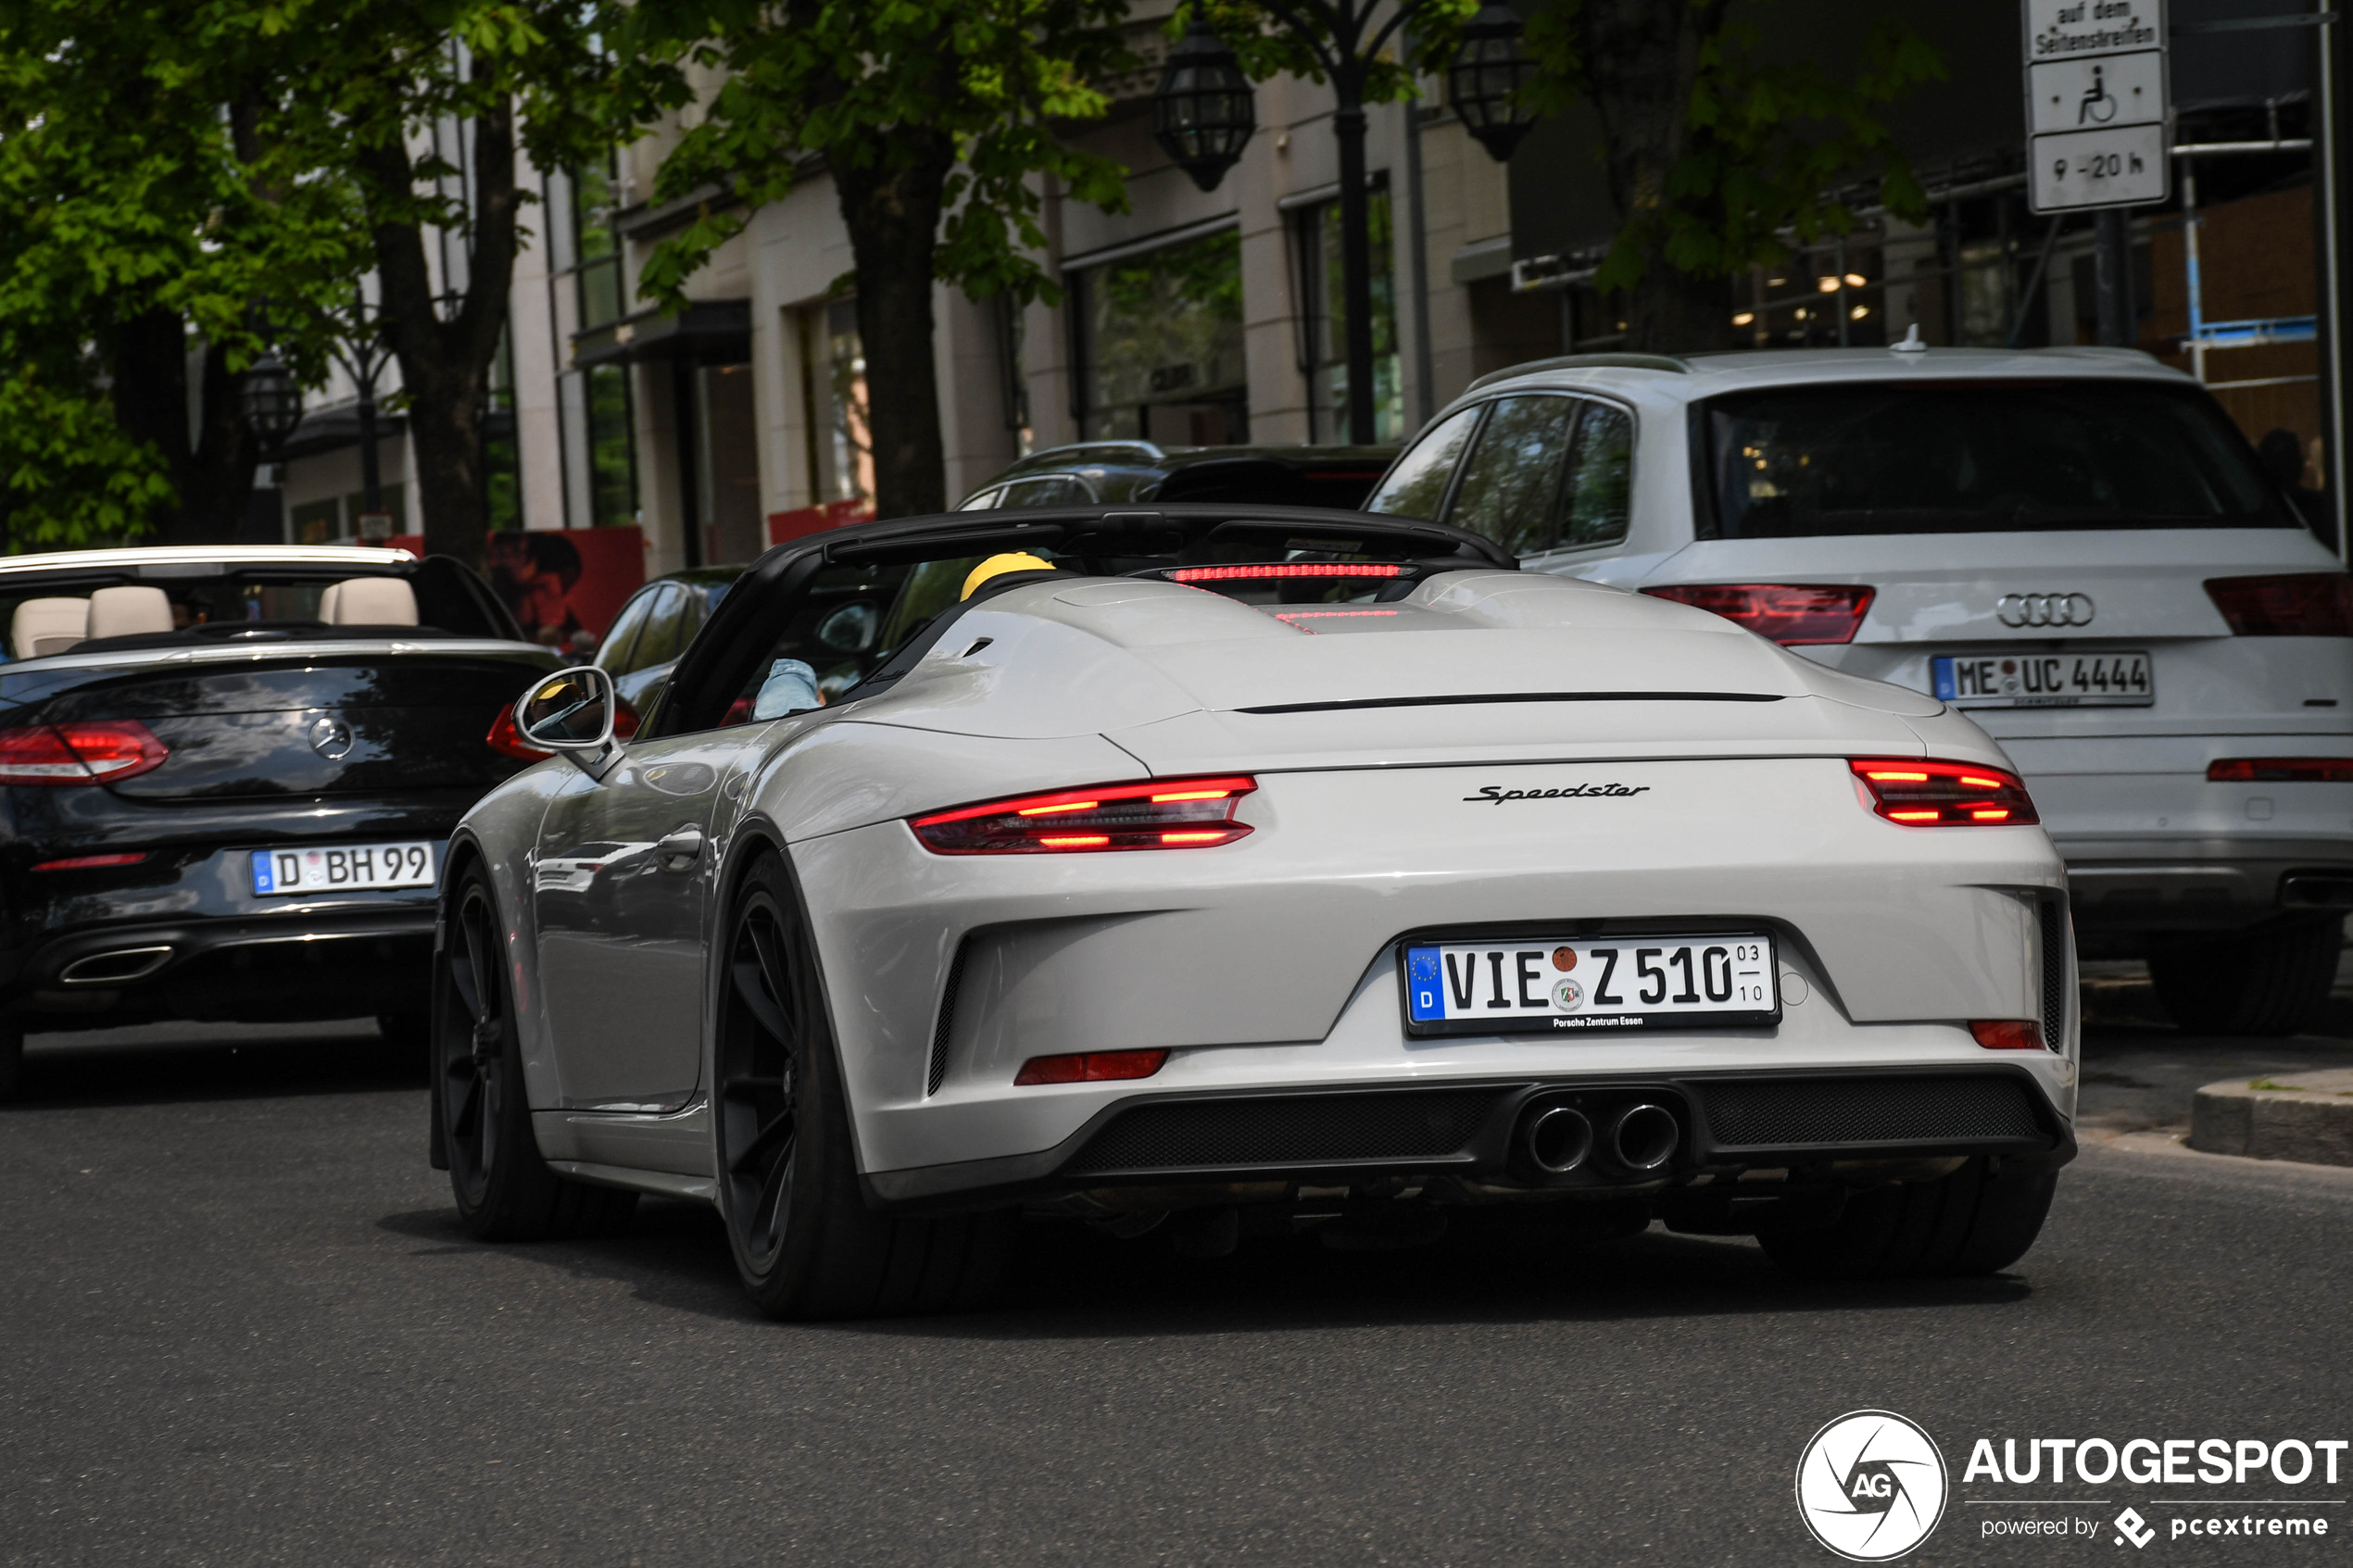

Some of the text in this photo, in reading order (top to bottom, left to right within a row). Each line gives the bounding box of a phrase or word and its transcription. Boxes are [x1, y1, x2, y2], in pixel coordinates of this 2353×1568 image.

[2057, 0, 2131, 24] auf dem
[2036, 25, 2155, 55] Seitenstreifen
[2129, 152, 2145, 174] h
[1957, 659, 2147, 696] ME UC 4444
[1463, 784, 1650, 806] Speedster
[276, 846, 426, 886] D BH 99
[1737, 945, 1760, 961] 03
[1446, 951, 1549, 1009] VIE
[1591, 948, 1623, 1005] Z
[1636, 947, 1733, 1004] 510
[1420, 991, 1433, 1009] D
[1739, 985, 1762, 1001] 10
[1554, 1016, 1643, 1027] Porsche Zentrum Essen
